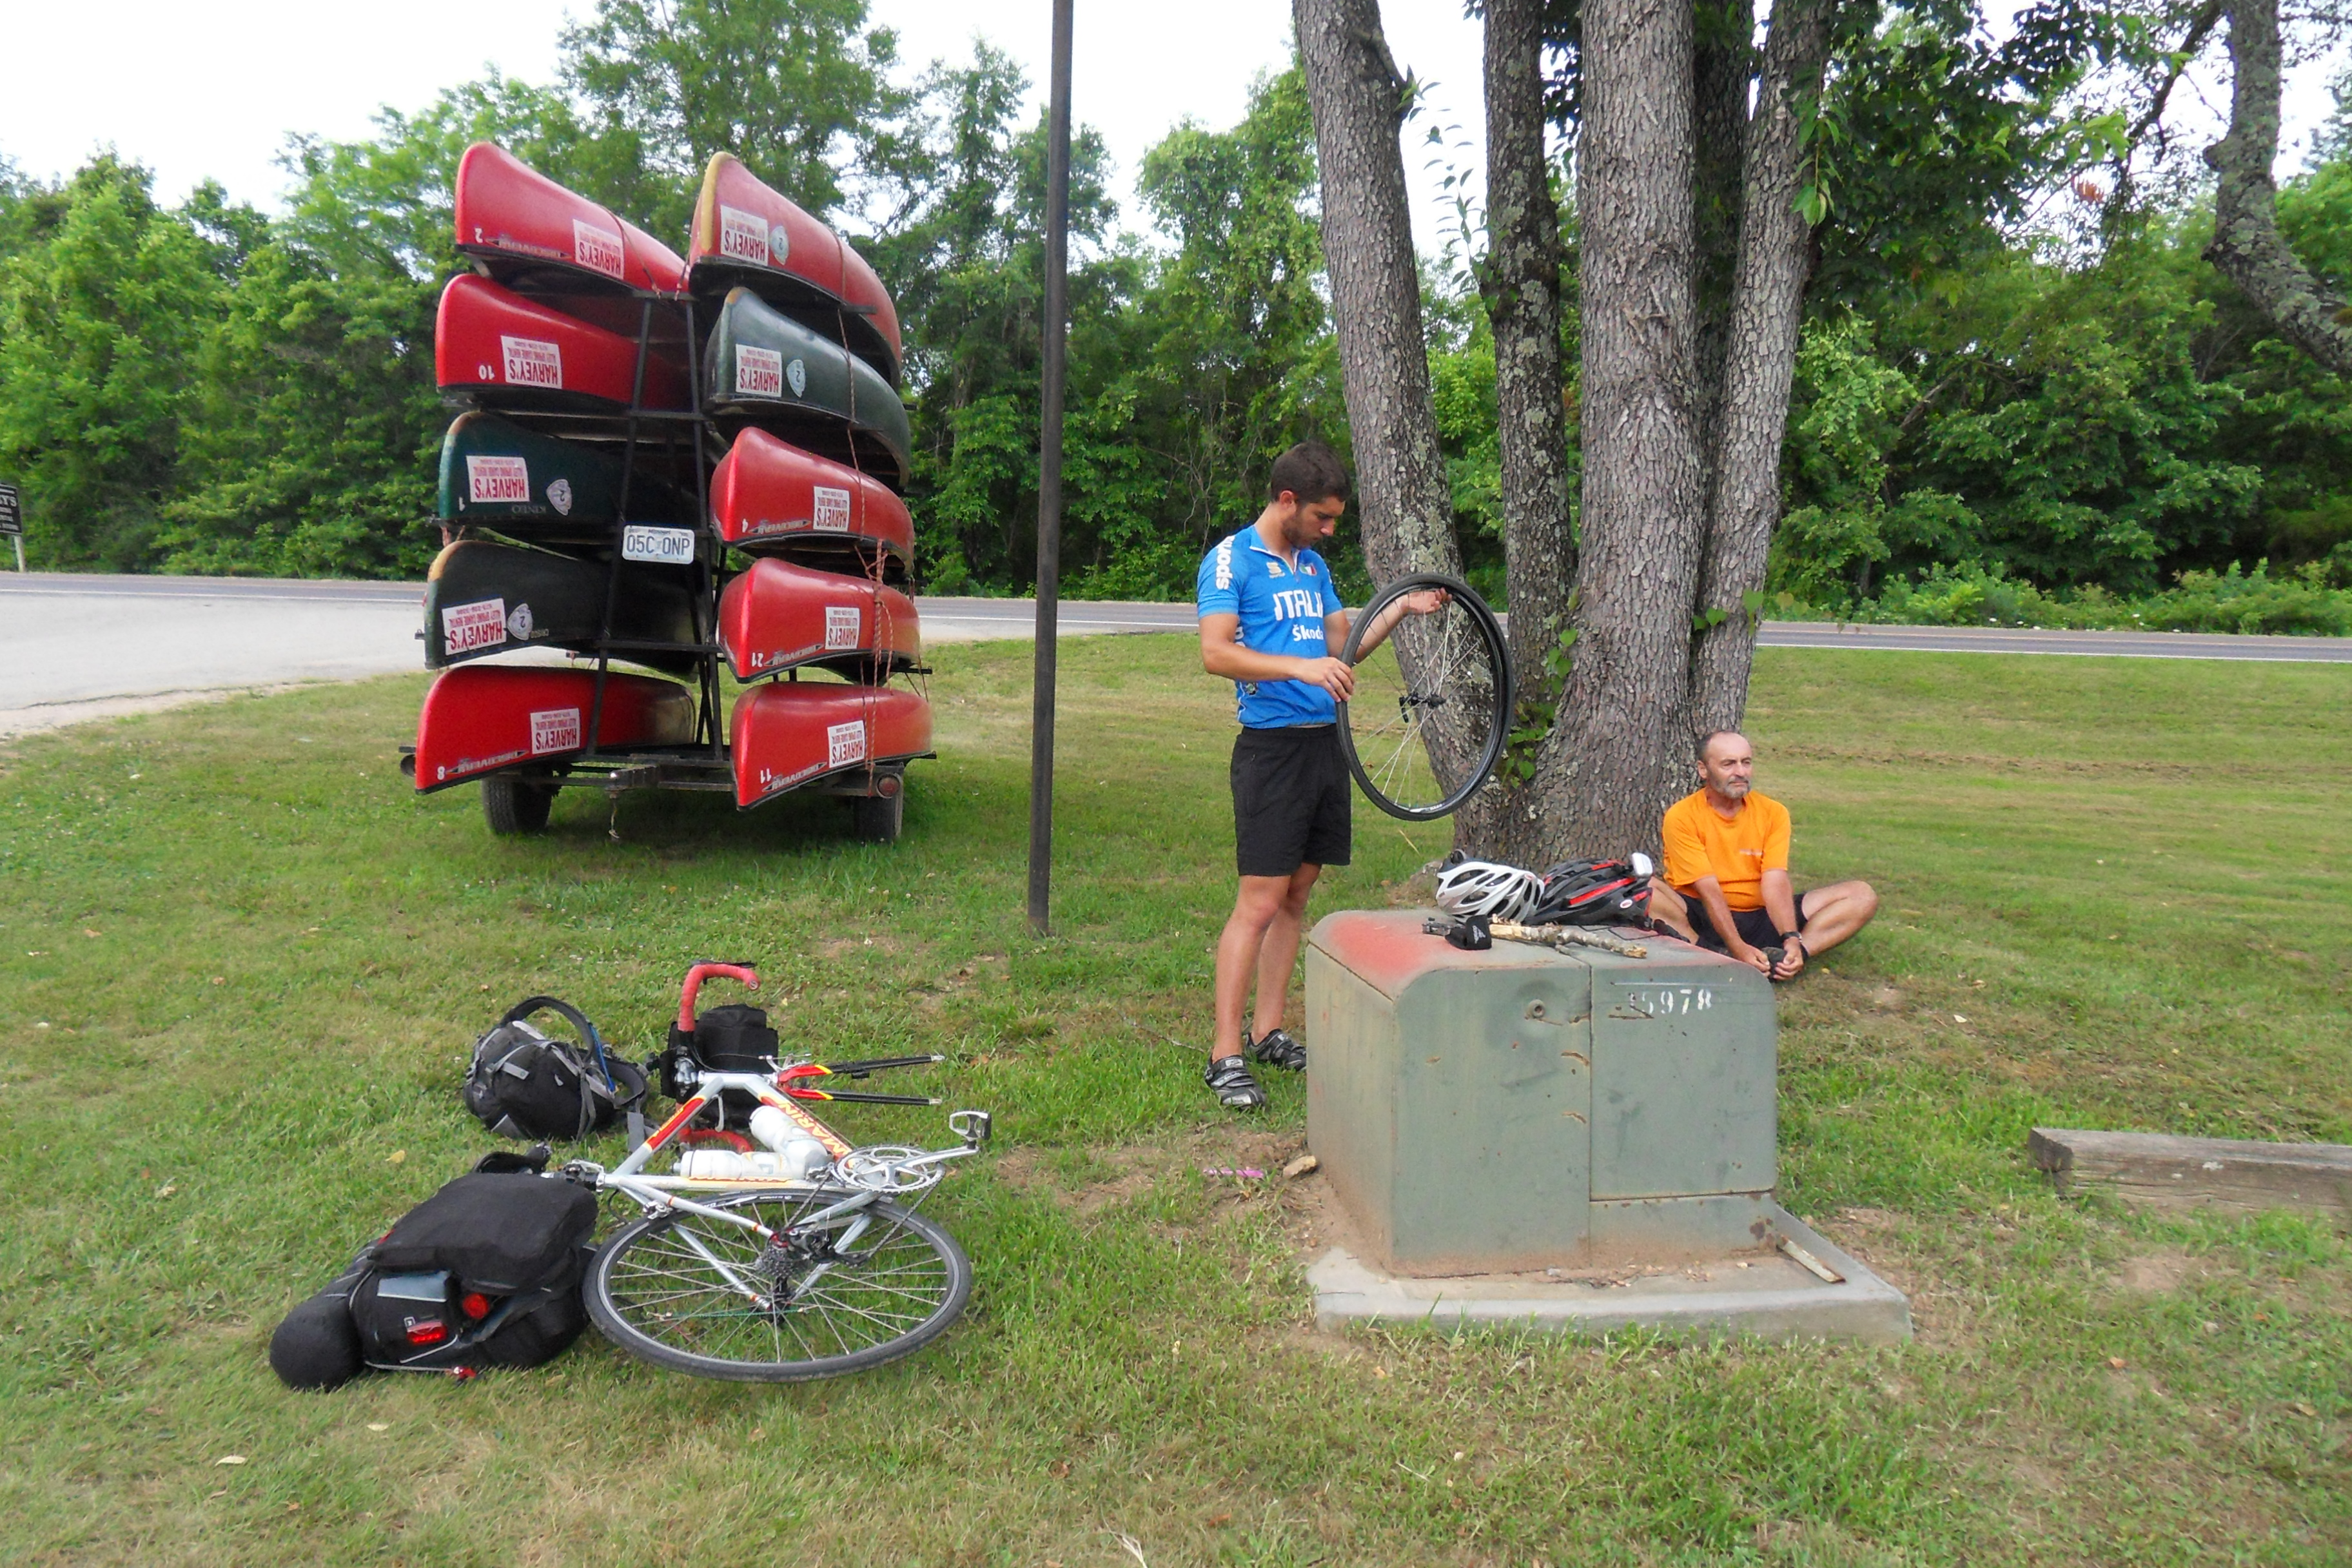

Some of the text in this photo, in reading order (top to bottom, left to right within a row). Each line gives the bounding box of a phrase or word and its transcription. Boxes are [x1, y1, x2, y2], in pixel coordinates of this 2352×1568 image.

[475, 228, 483, 243] 2
[725, 230, 765, 261] HARVEY'S
[579, 241, 621, 275] HARVEY'S
[479, 365, 495, 380] 10
[509, 358, 558, 385] HARVEY'S
[740, 368, 779, 393] HARVEY'S
[796, 370, 801, 383] 2
[475, 478, 525, 498] HARVEY'S
[559, 490, 565, 502] 2
[742, 518, 749, 533] 4
[817, 507, 847, 528] HARVEY'S
[627, 534, 654, 553] 05C
[520, 616, 526, 628] 2
[449, 621, 502, 650] HARVEY'S
[828, 627, 857, 647] HARVEY'S
[752, 652, 764, 668] 21
[536, 728, 576, 750] HARVEY'S
[832, 740, 863, 764] HARVEY'S
[437, 766, 446, 780] 8
[761, 768, 772, 784] 11
[778, 1103, 850, 1155] MARIN
